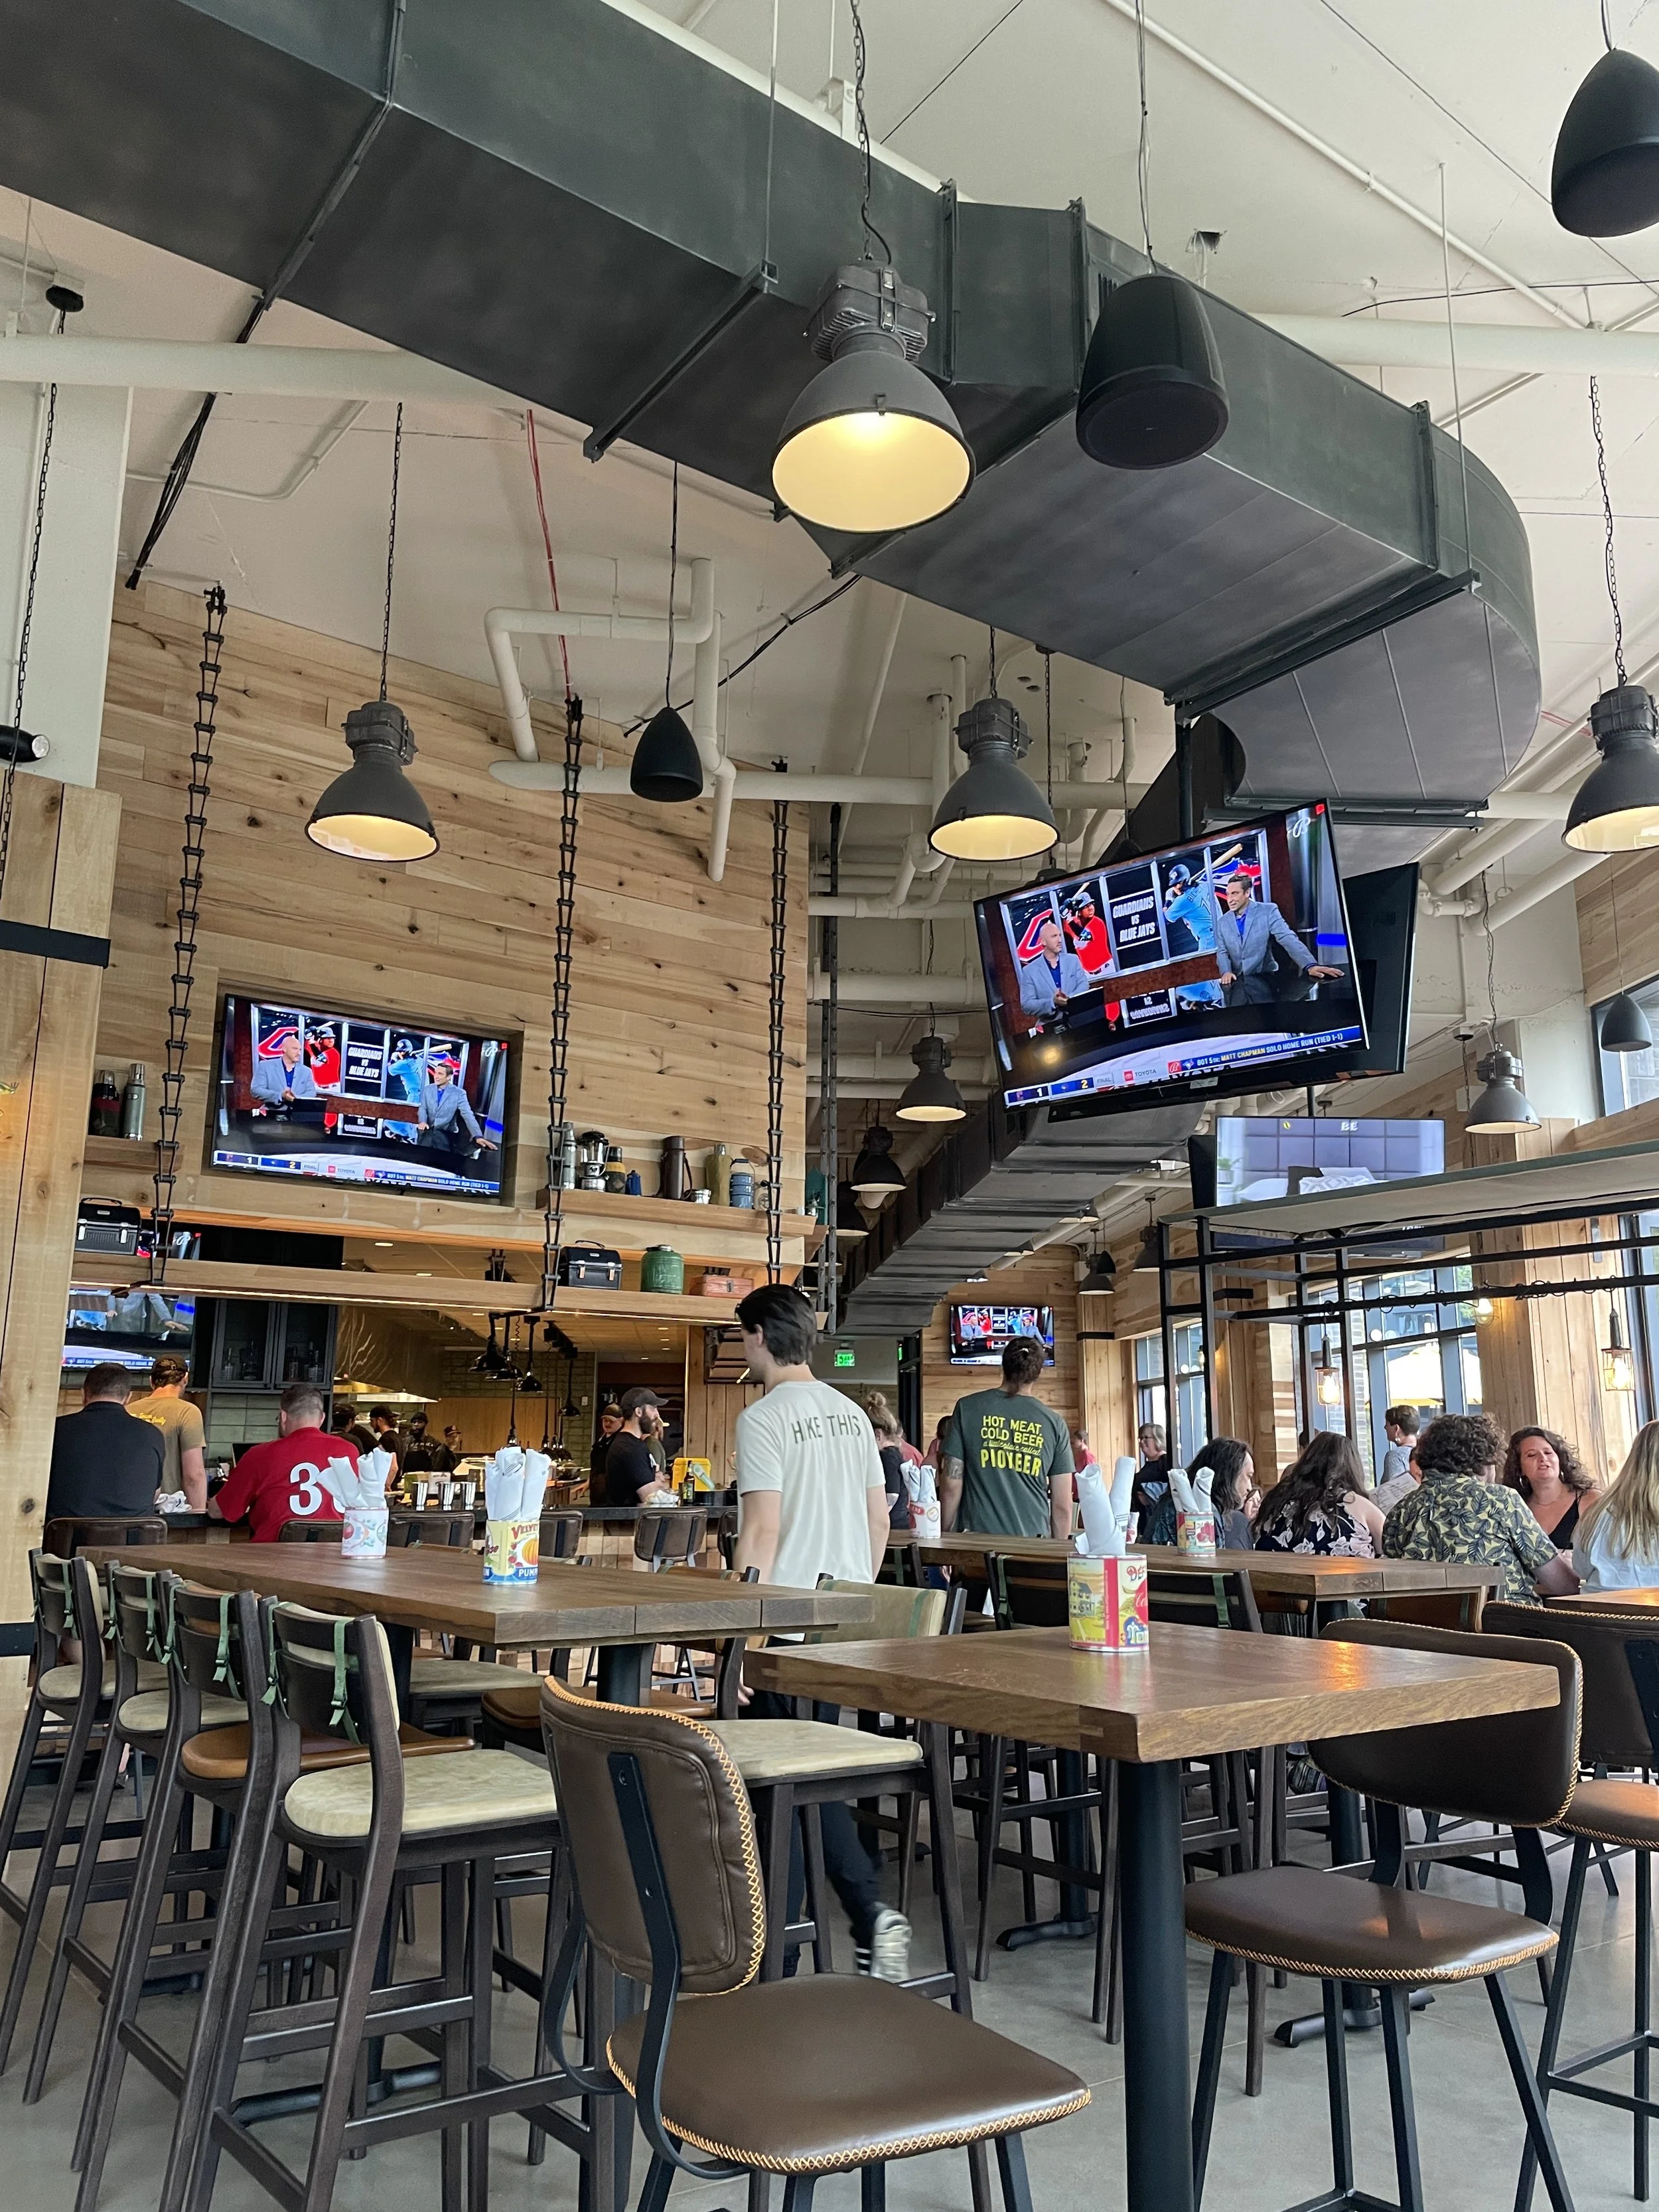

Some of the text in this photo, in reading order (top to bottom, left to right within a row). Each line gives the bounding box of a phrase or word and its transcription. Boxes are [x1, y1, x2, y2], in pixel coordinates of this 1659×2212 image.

[1112, 897, 1153, 919] GUARDIANS
[1131, 915, 1139, 924] VS
[1119, 922, 1155, 942] BLUE JAYS
[348, 1047, 383, 1060] GUARDIANS
[1221, 1053, 1236, 1062] MATT
[1237, 1048, 1265, 1059] CHAPMAN
[1266, 1045, 1282, 1053] SOLO
[1283, 1041, 1299, 1051] HOME
[1301, 1039, 1314, 1047] RUN
[1315, 1035, 1331, 1045] (TIED
[1331, 1033, 1343, 1041] 1-1)
[349, 1065, 380, 1078] BLUE JAYS
[1135, 1069, 1157, 1077] TOYOTA
[1080, 1079, 1088, 1088] 2
[1037, 1087, 1043, 1097] 1
[983, 1416, 1005, 1428] HOT
[791, 1414, 861, 1444] HKE THIS
[981, 1427, 1044, 1448] COLD BEER
[1020, 1447, 1041, 1456] called
